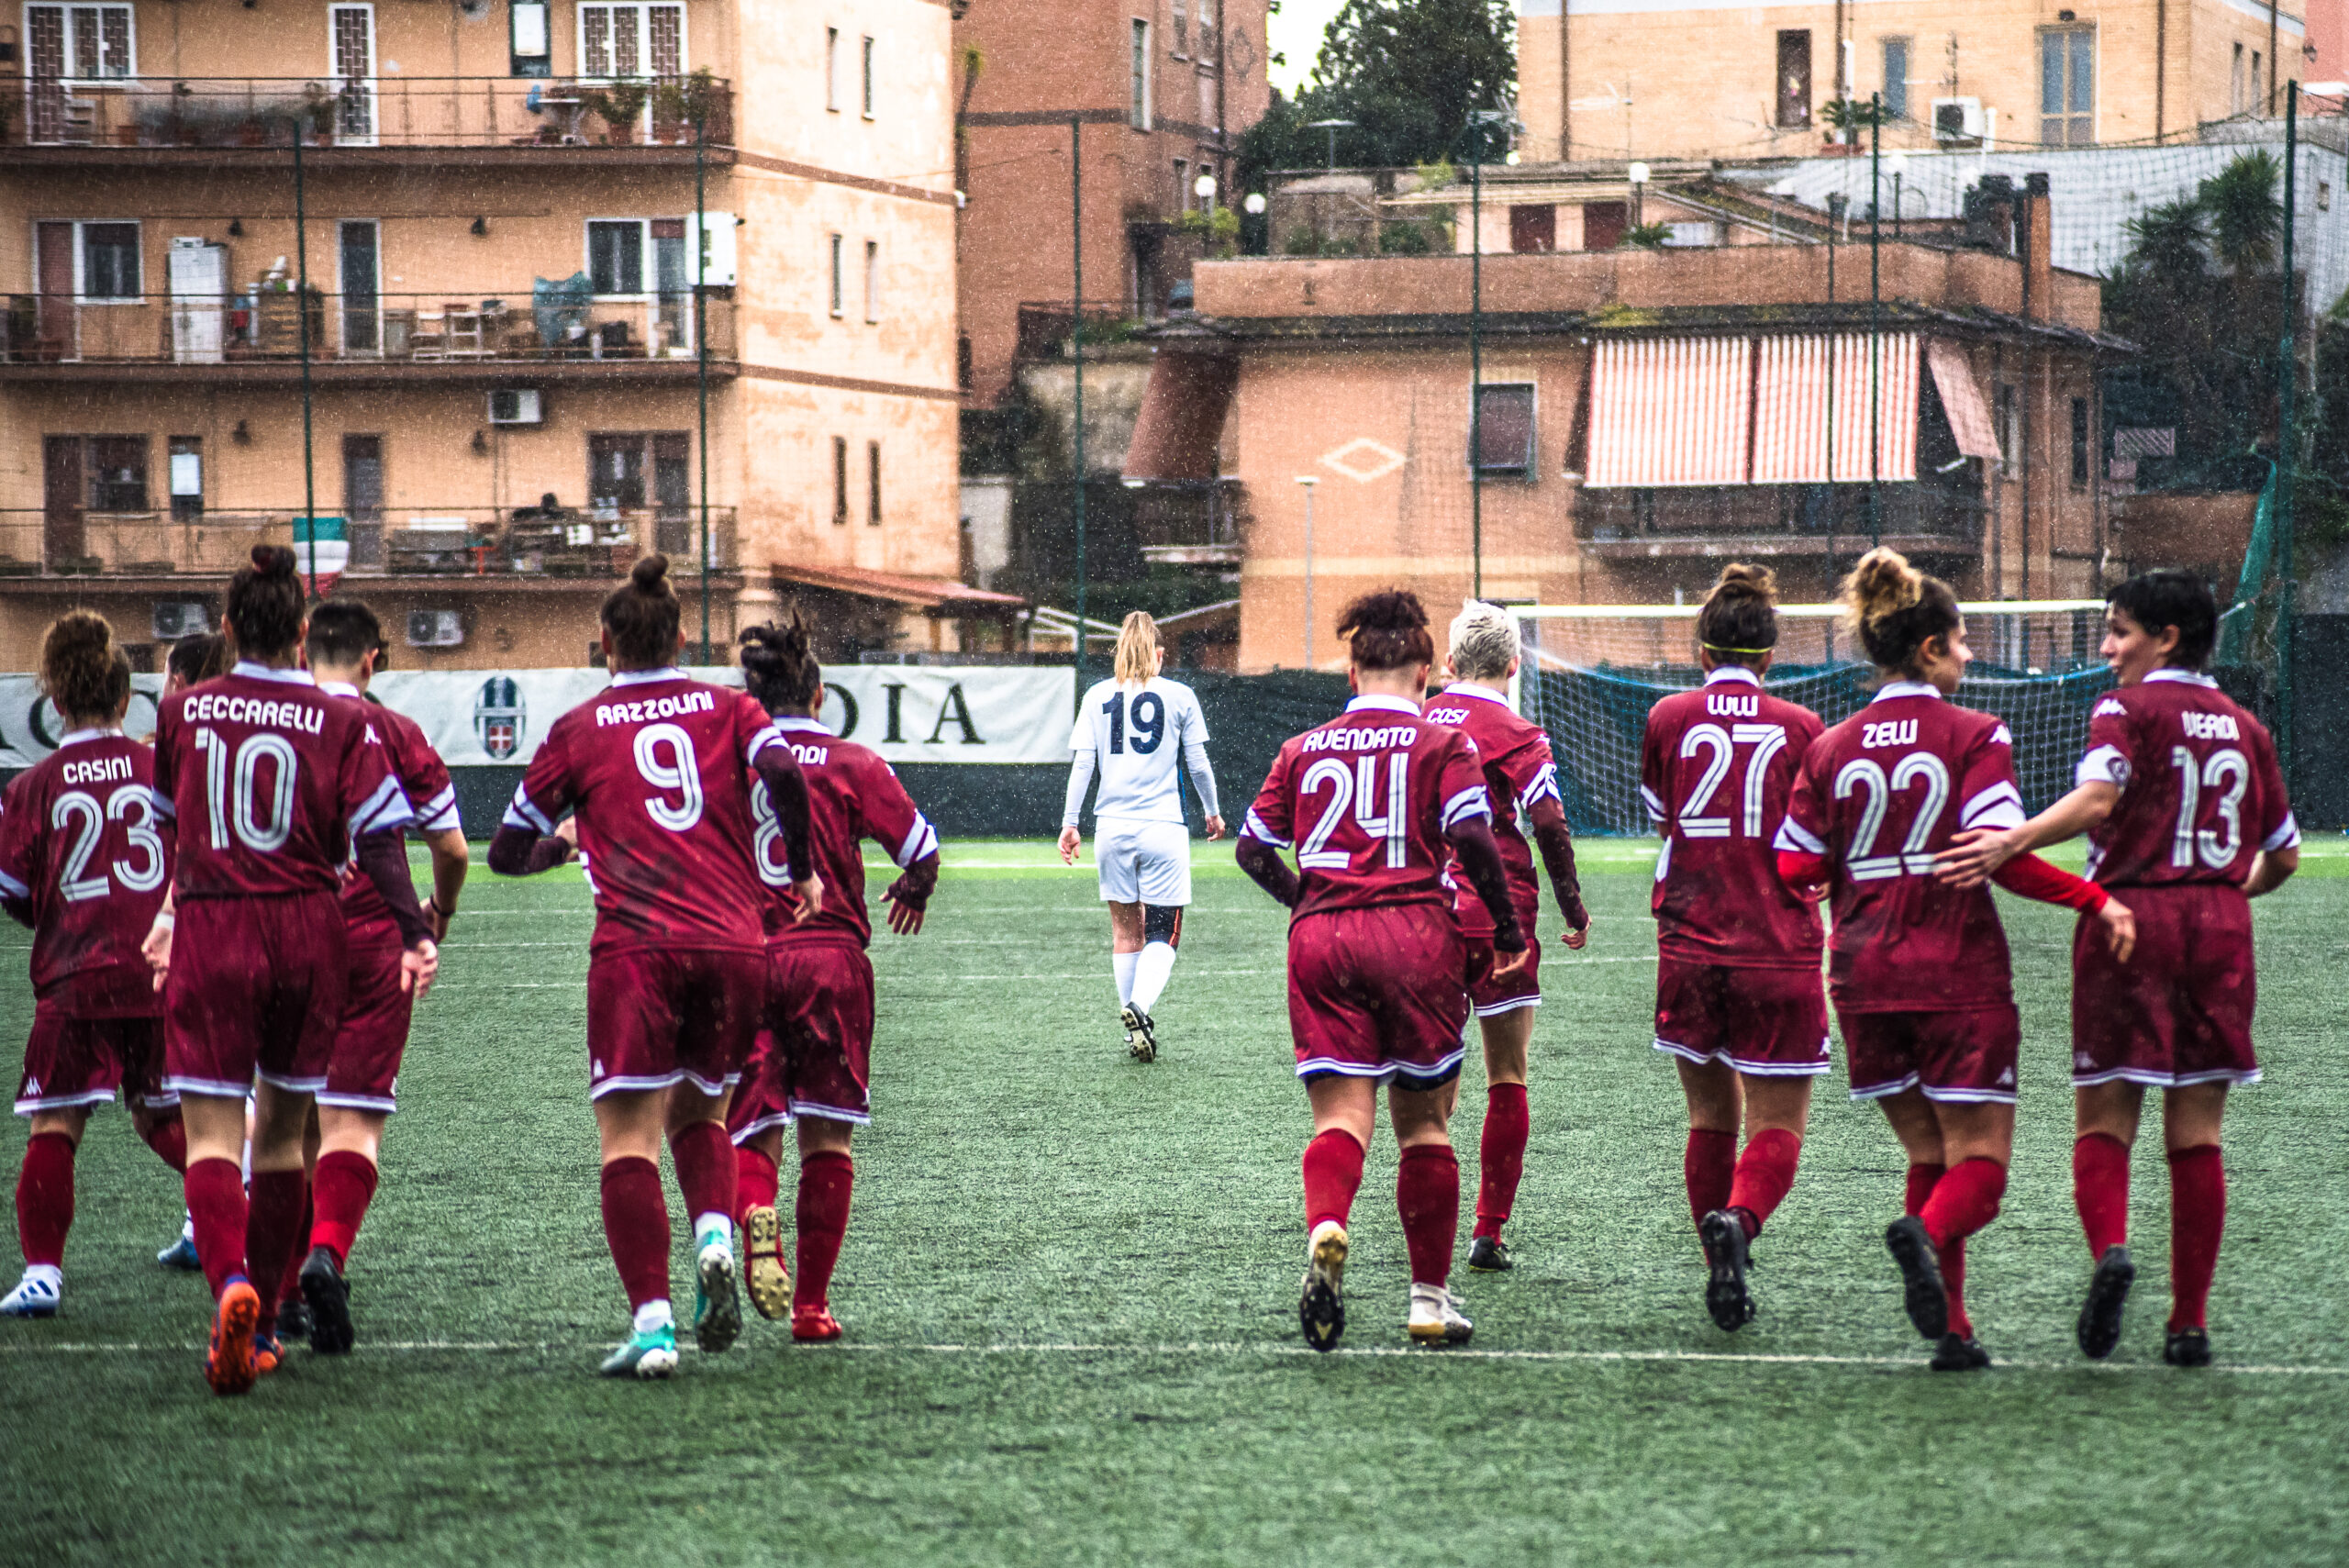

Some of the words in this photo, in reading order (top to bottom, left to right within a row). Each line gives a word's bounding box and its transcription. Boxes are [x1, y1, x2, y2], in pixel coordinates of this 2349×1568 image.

[184, 694, 325, 735] CECCARELLI
[596, 690, 715, 728] RAZZOLINI
[823, 682, 987, 745] DIA
[1101, 691, 1165, 755] 19
[1302, 726, 1418, 753] AVENDATO
[62, 755, 133, 784] CASINI
[195, 727, 297, 851] 10
[632, 722, 704, 832] 9
[790, 743, 829, 765] NDI
[1679, 723, 1787, 838] 27
[51, 784, 165, 903] 23
[1298, 751, 1409, 869] 24
[1834, 751, 1954, 881] 22
[2171, 745, 2249, 869] 13
